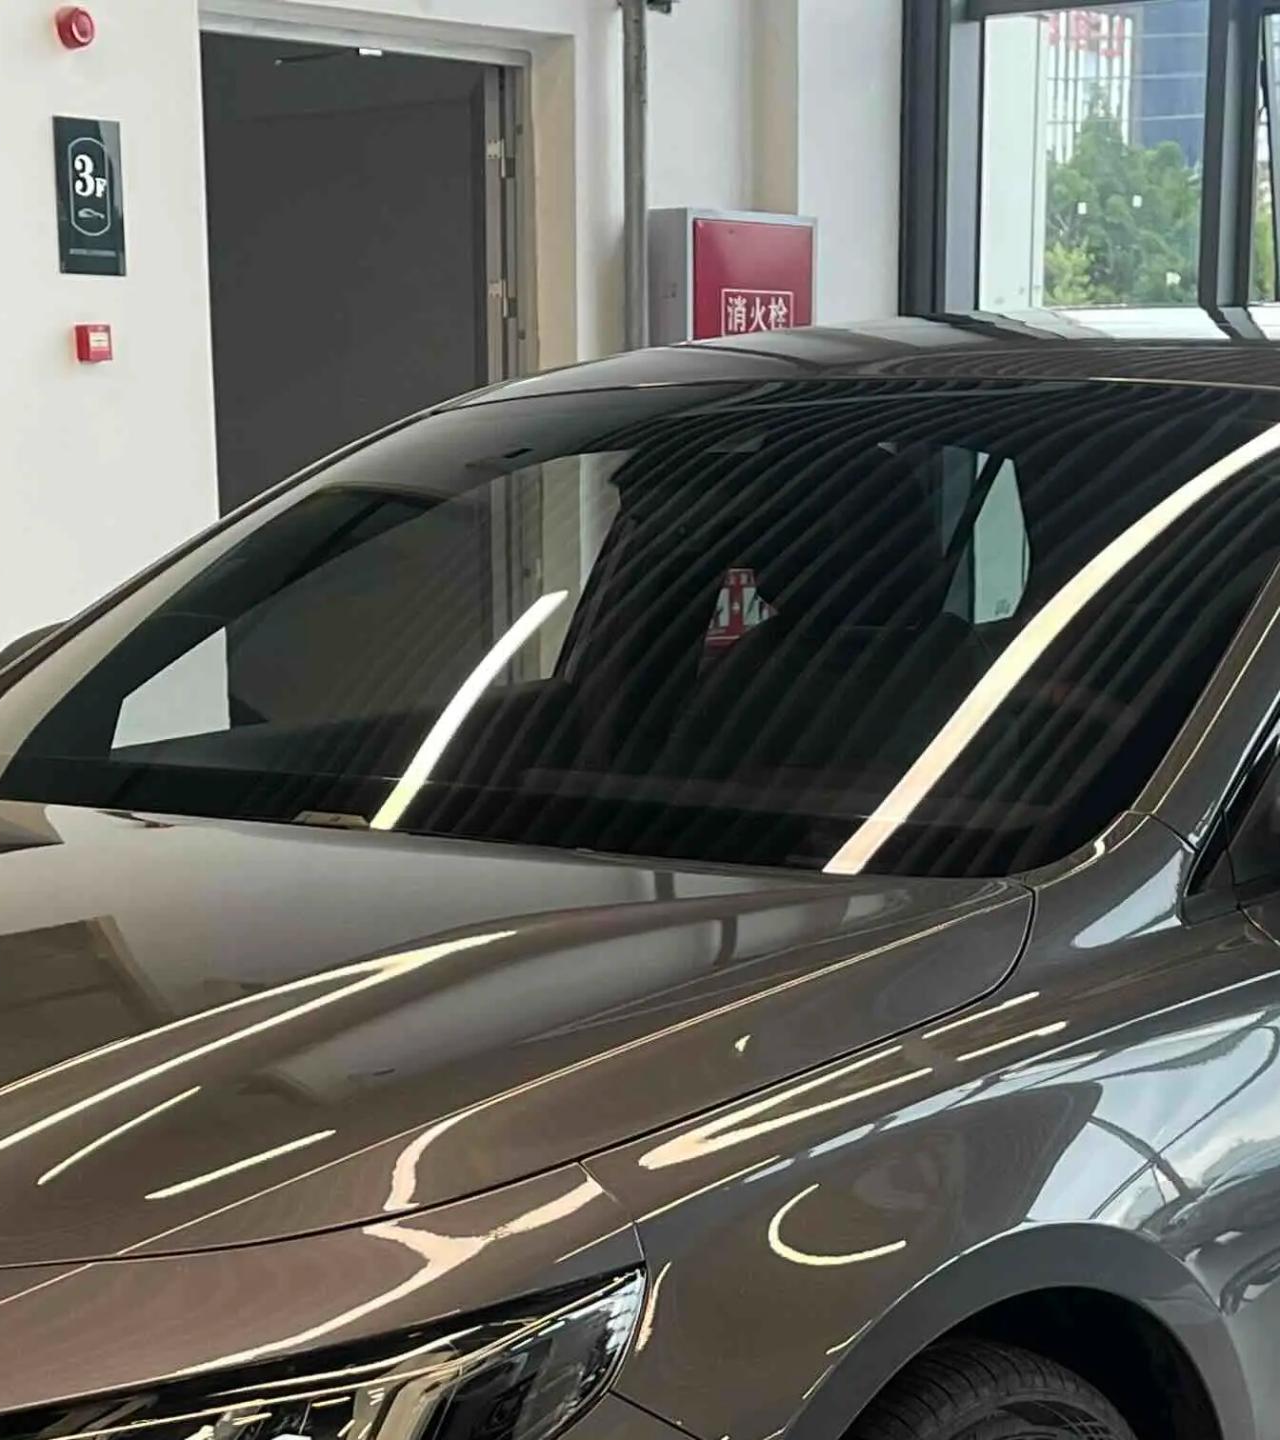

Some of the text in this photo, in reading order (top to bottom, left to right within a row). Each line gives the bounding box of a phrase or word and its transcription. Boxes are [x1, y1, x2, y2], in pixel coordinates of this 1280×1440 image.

[73, 153, 107, 198] 3F
[726, 295, 788, 333] 消火栓
